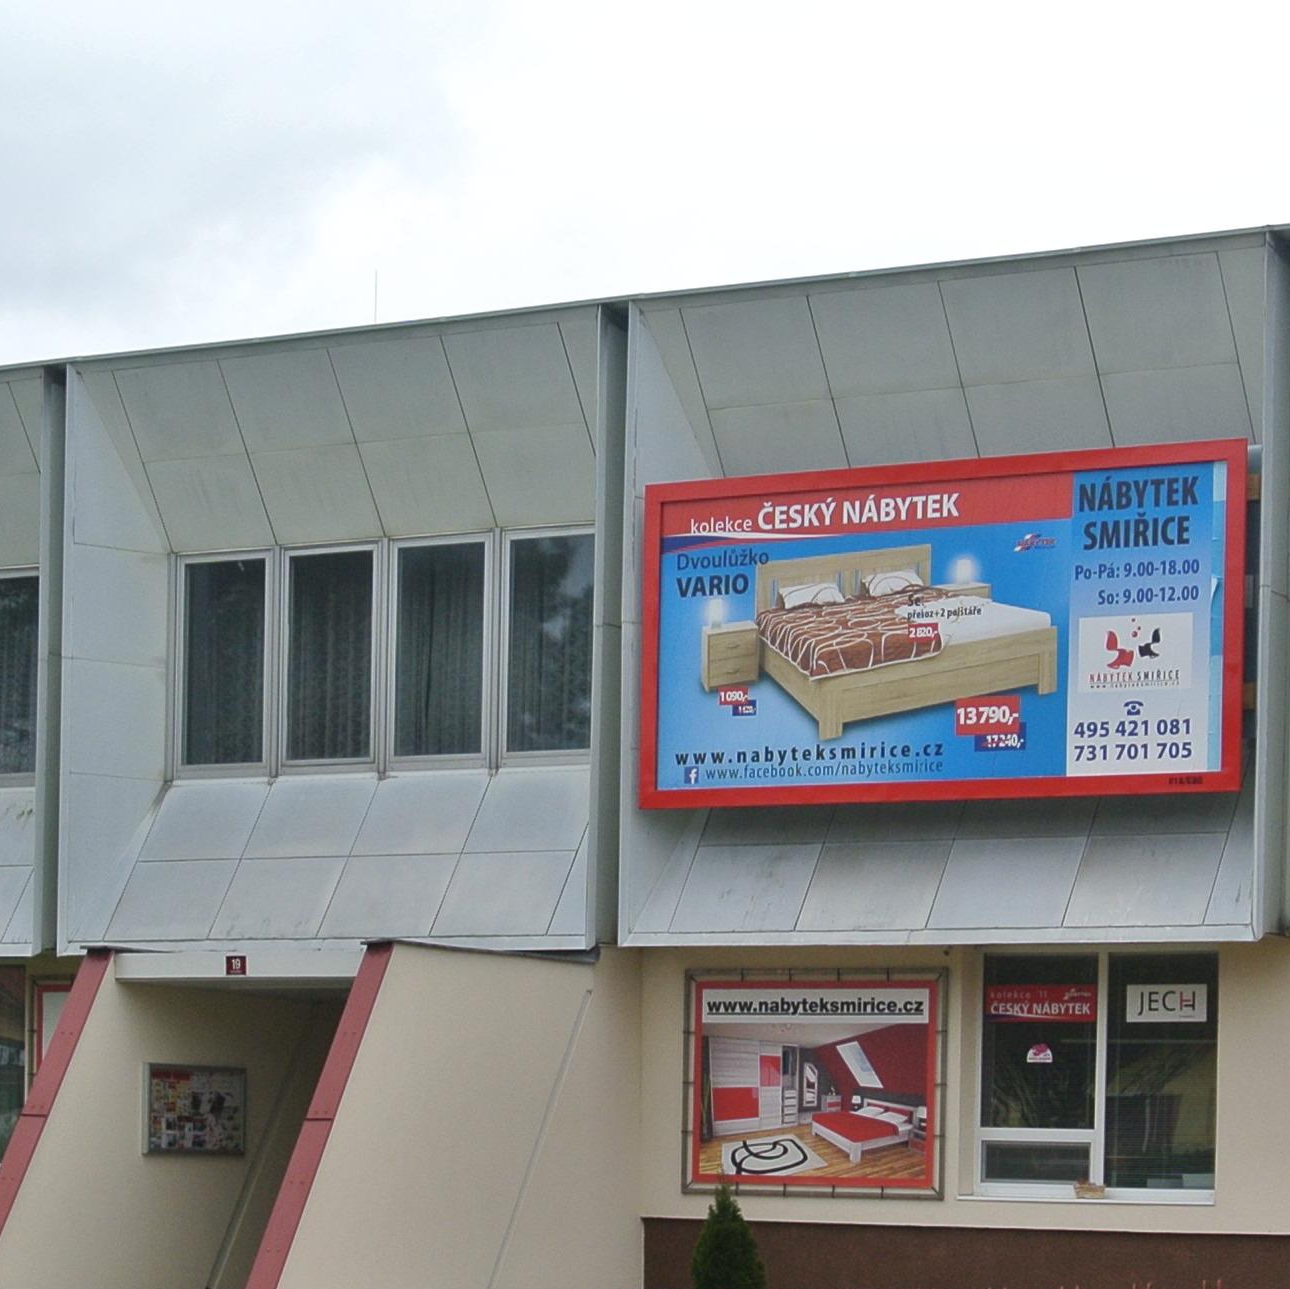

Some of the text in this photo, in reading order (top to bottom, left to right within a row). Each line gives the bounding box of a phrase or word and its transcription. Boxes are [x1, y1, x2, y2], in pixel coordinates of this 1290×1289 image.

[1079, 475, 1199, 513] NÁBYTEK
[690, 492, 960, 535] kolekce ČESKÝ NÁBYTEK
[1082, 512, 1191, 551] SMIŘICE
[676, 548, 770, 571] Dvoulůžko
[1074, 558, 1200, 581] Po-Pá: 9.00-18.00
[676, 573, 750, 598] VARIO
[1098, 585, 1199, 606] So: 9.00-12.00
[1074, 718, 1191, 738] 495 421 081
[675, 742, 945, 766] www.nabyteksmirice.cz
[1074, 742, 1193, 762] 731 701 705
[705, 759, 945, 781] www.facebook.com/nabyteksmirice
[707, 997, 925, 1016] www.nabyteksmirice.cz
[990, 998, 1091, 1015] ČESKÝ NÁBYTEK
[1137, 990, 1196, 1017] JECH
